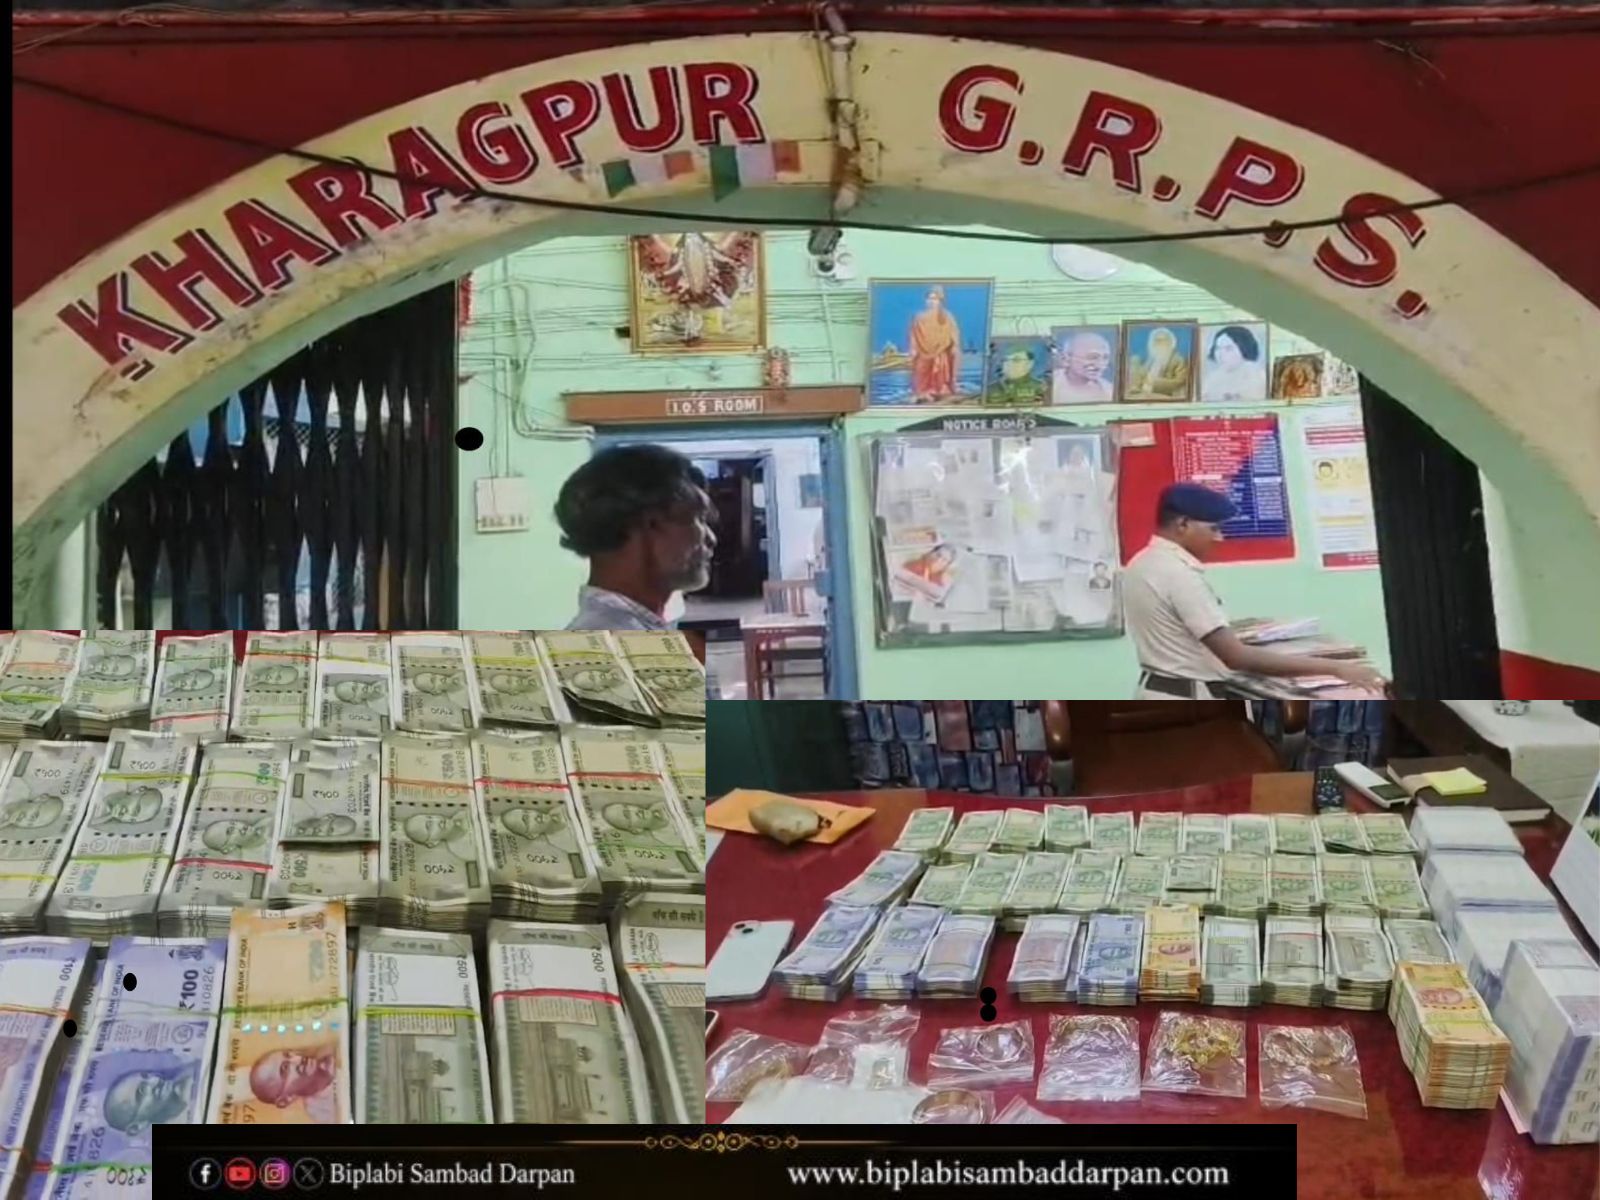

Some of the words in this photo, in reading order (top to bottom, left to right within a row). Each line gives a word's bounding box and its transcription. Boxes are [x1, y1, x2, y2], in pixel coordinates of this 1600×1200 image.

[57, 61, 765, 381] KHARAGPUR
[715, 398, 757, 412] ROOM
[943, 419, 988, 431] NOTICE
[179, 969, 199, 1011] ₹100
